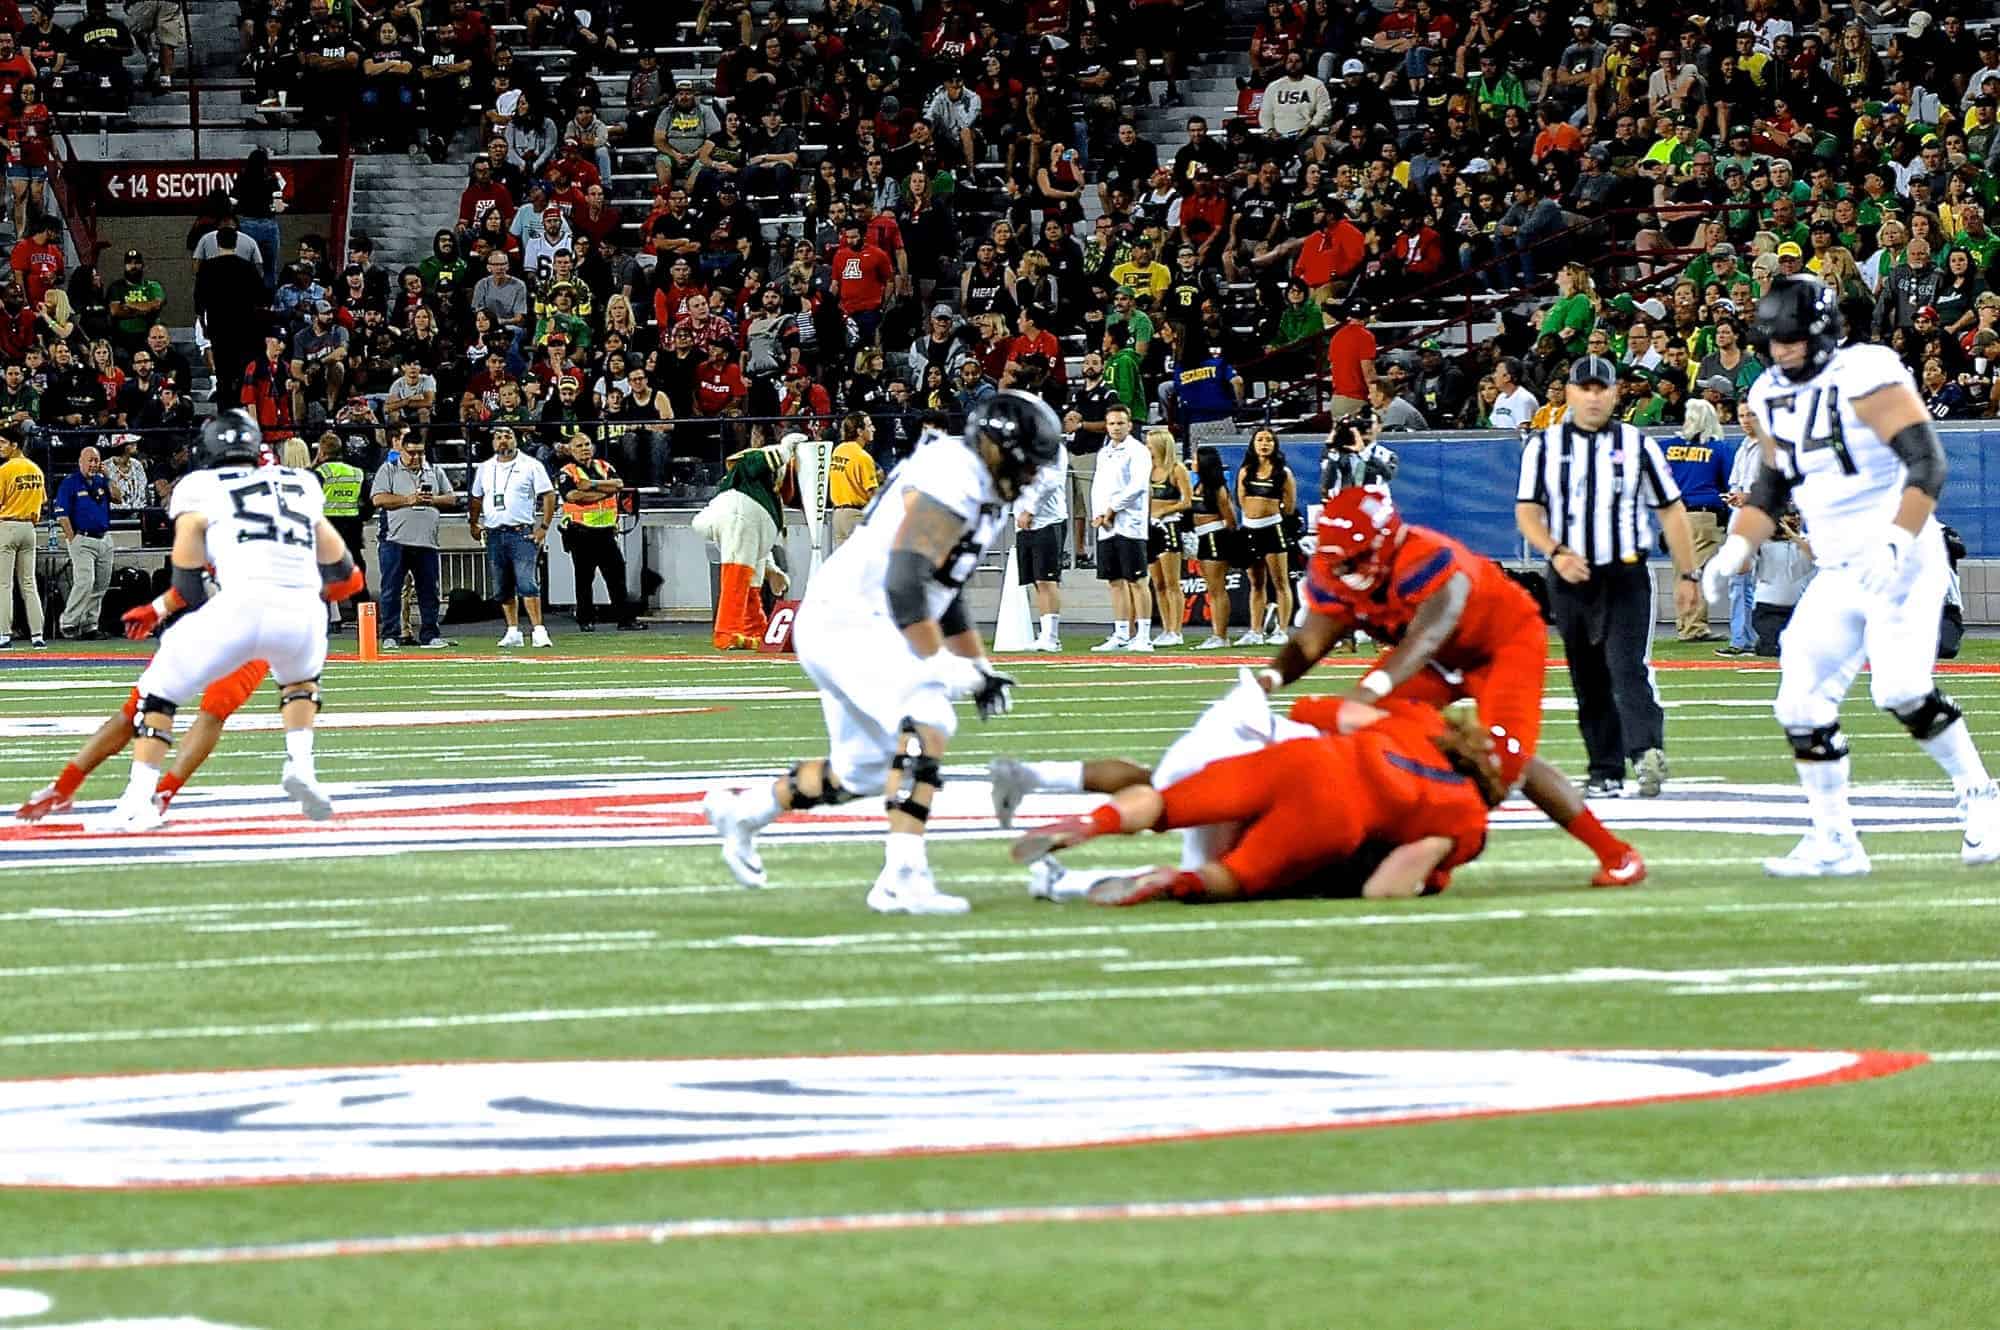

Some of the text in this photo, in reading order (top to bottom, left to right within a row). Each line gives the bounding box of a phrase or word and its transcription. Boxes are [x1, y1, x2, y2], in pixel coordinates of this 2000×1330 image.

[1277, 89, 1311, 105] USA
[128, 172, 238, 198] 14 SECTION
[842, 258, 863, 279] A
[972, 286, 1000, 298] HEAT
[1180, 291, 1192, 306] 13
[1179, 366, 1217, 384] SECURITY
[1932, 402, 1949, 418] 10
[1764, 385, 1859, 485] 54
[1666, 445, 1713, 462] SECURITY
[816, 444, 826, 521] OREGON
[332, 489, 353, 497] POLICE
[229, 480, 314, 551] 55
[764, 608, 794, 644] G
